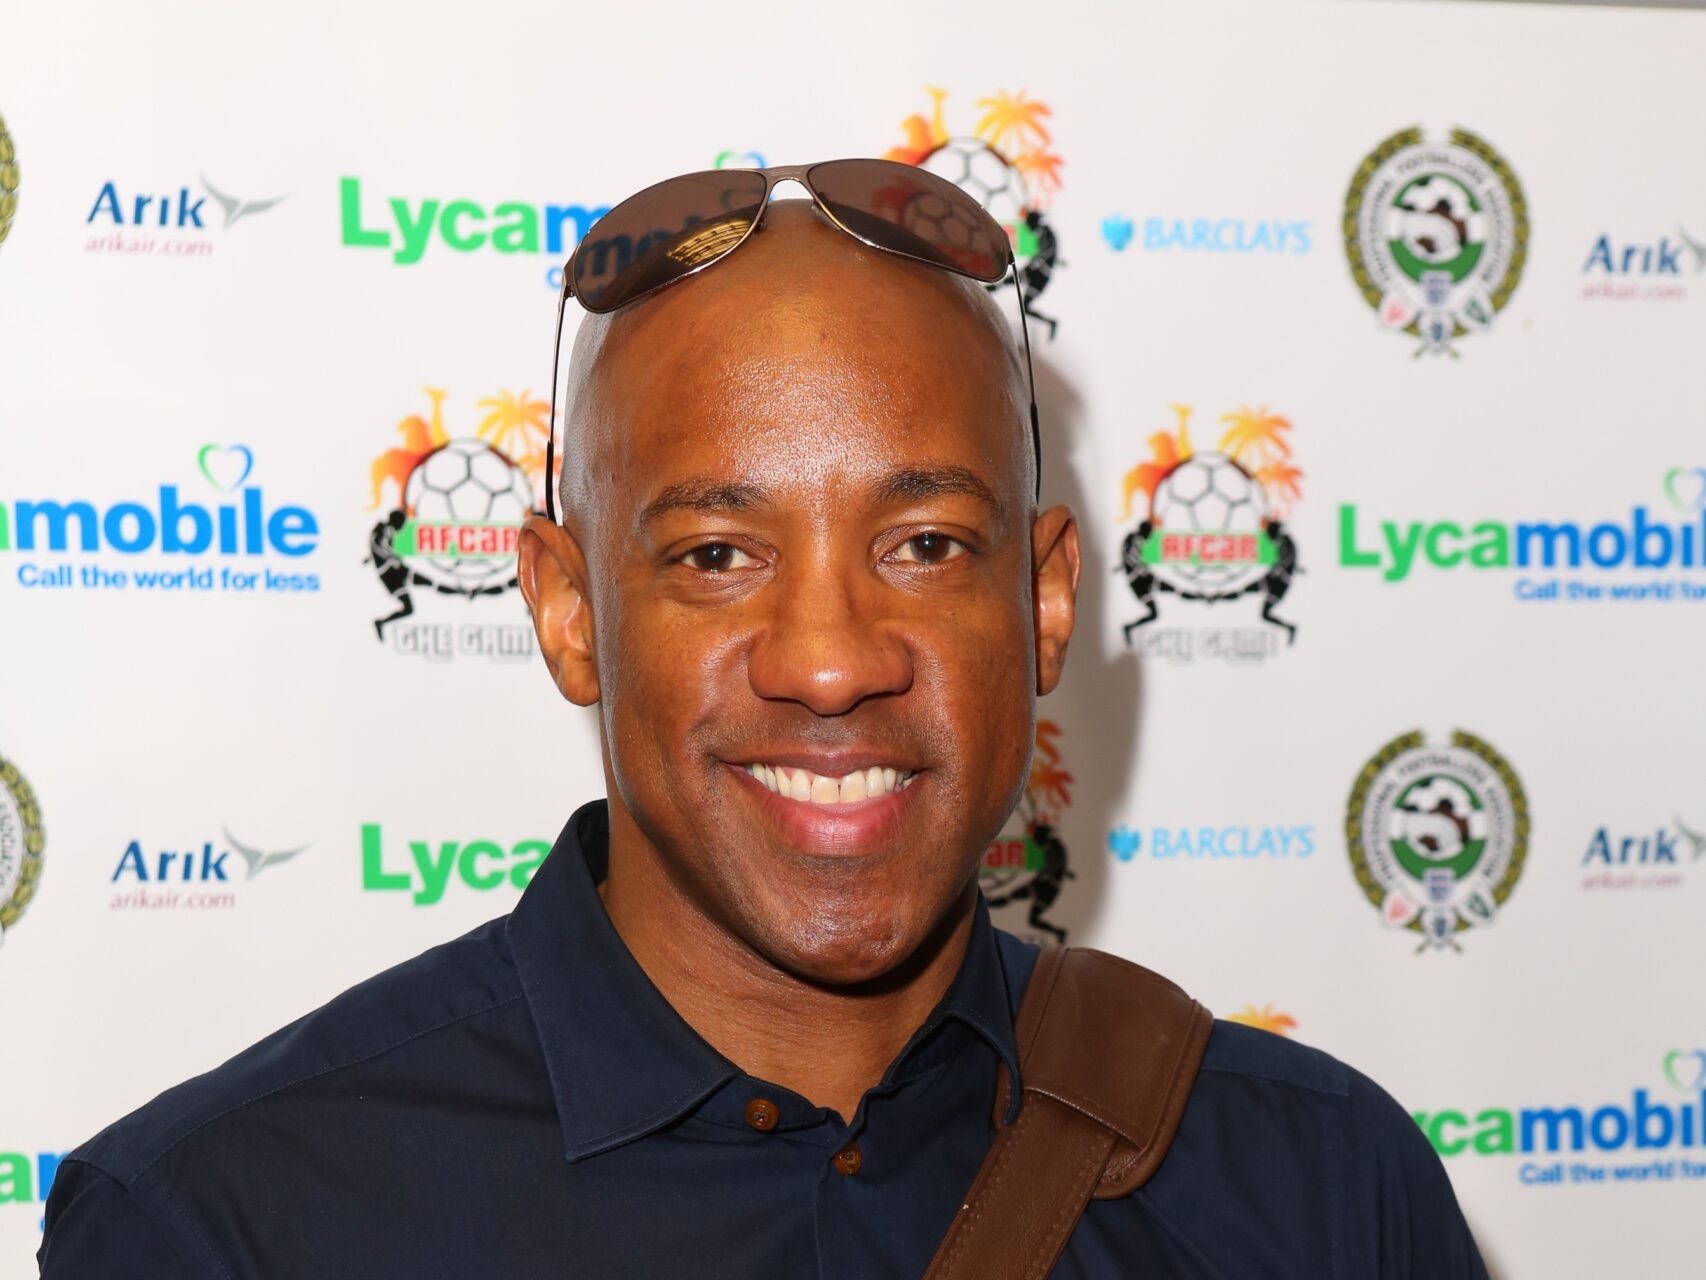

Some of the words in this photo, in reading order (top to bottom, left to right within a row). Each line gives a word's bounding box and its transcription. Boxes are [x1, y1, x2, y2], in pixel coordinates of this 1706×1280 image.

[87, 180, 207, 229] Arik
[85, 232, 213, 257] arikair.com
[1144, 216, 1312, 254] BARCLAYS
[1582, 234, 1682, 272] Arik
[0, 484, 319, 556] mobile
[17, 563, 72, 587] Call
[81, 565, 127, 587] the
[135, 567, 213, 590] world
[221, 568, 258, 591] for
[265, 569, 320, 593] less
[1515, 580, 1557, 600] Call
[1567, 580, 1602, 599] the
[1611, 580, 1673, 599] world
[1151, 824, 1314, 858] BARCLAYS
[1581, 826, 1678, 864] Arik
[111, 840, 230, 883] Arik
[361, 824, 553, 906] Lyca
[110, 889, 236, 911] arikair.com
[1519, 1163, 1562, 1184] Call
[1571, 1162, 1606, 1181] the
[1614, 1160, 1674, 1180] world
